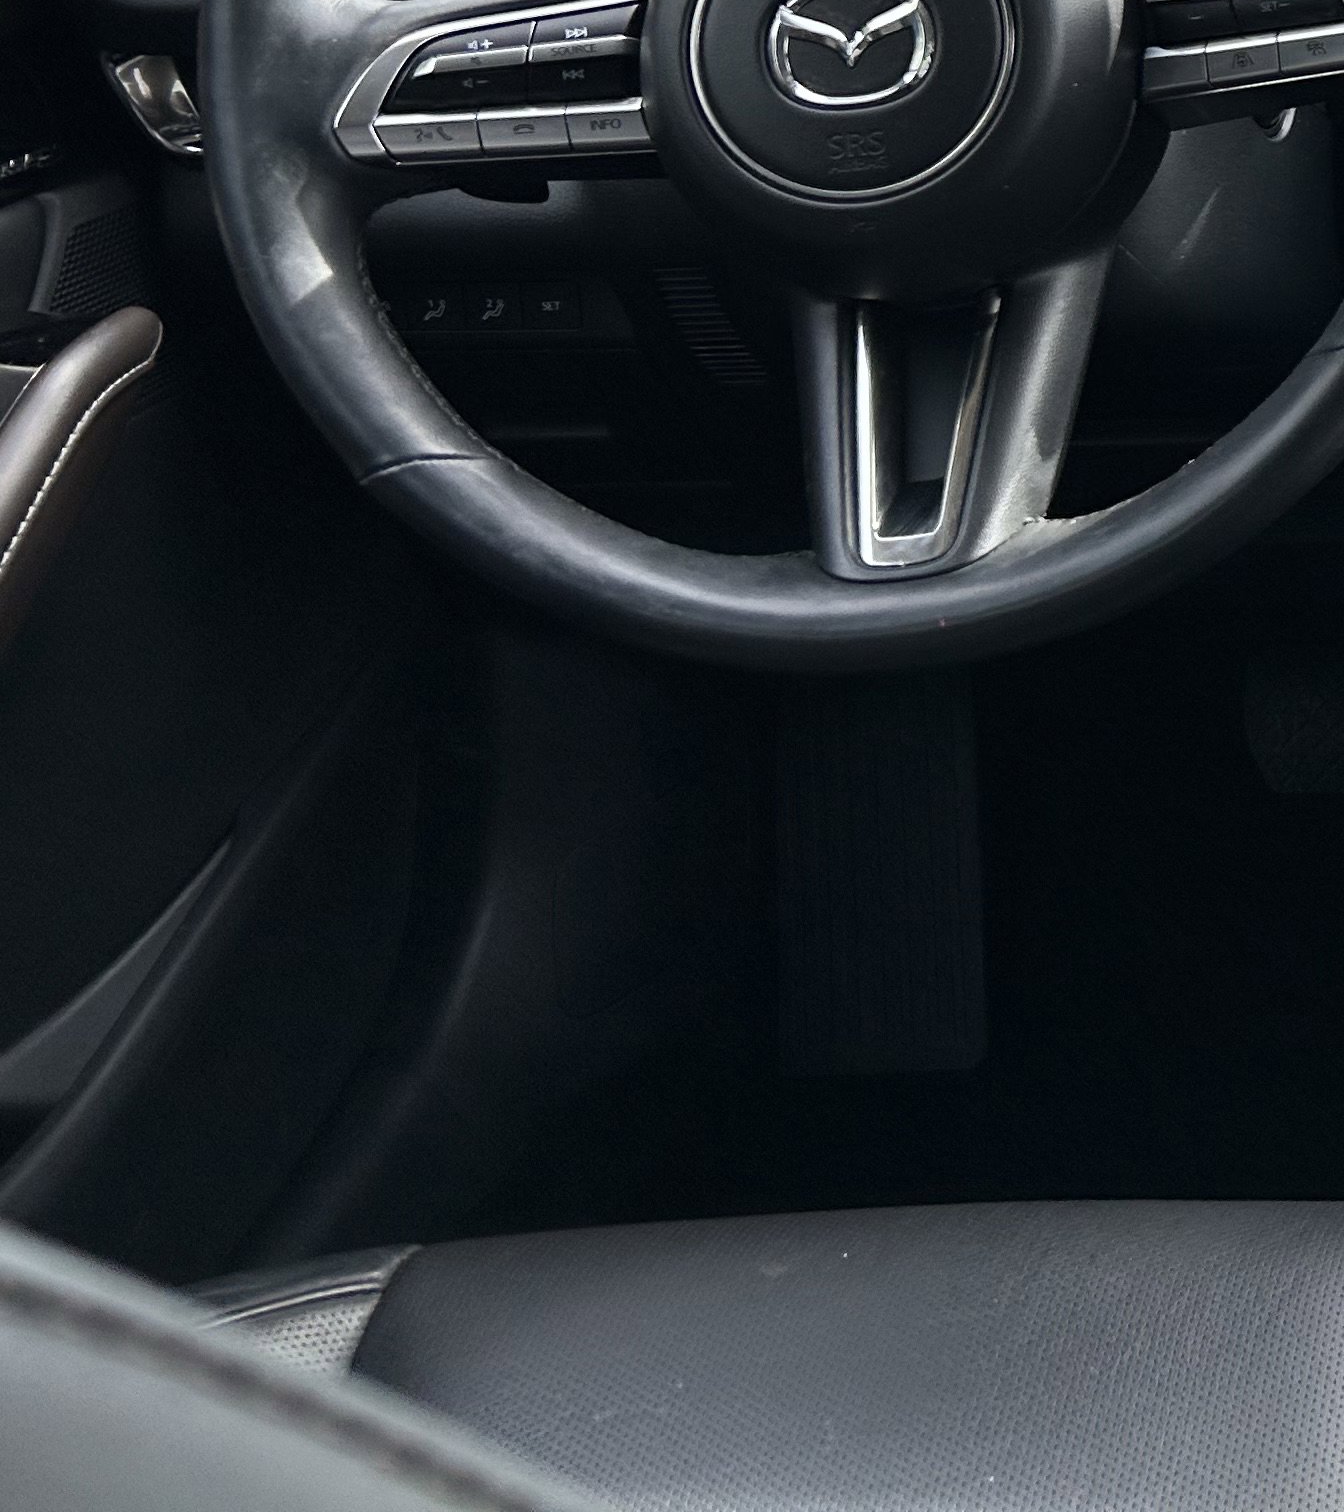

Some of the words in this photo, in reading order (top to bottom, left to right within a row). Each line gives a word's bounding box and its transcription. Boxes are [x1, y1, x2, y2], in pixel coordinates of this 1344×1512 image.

[551, 43, 598, 57] SOURCE
[590, 118, 623, 131] INFO
[827, 131, 886, 160] SRS
[542, 301, 561, 311] SET
